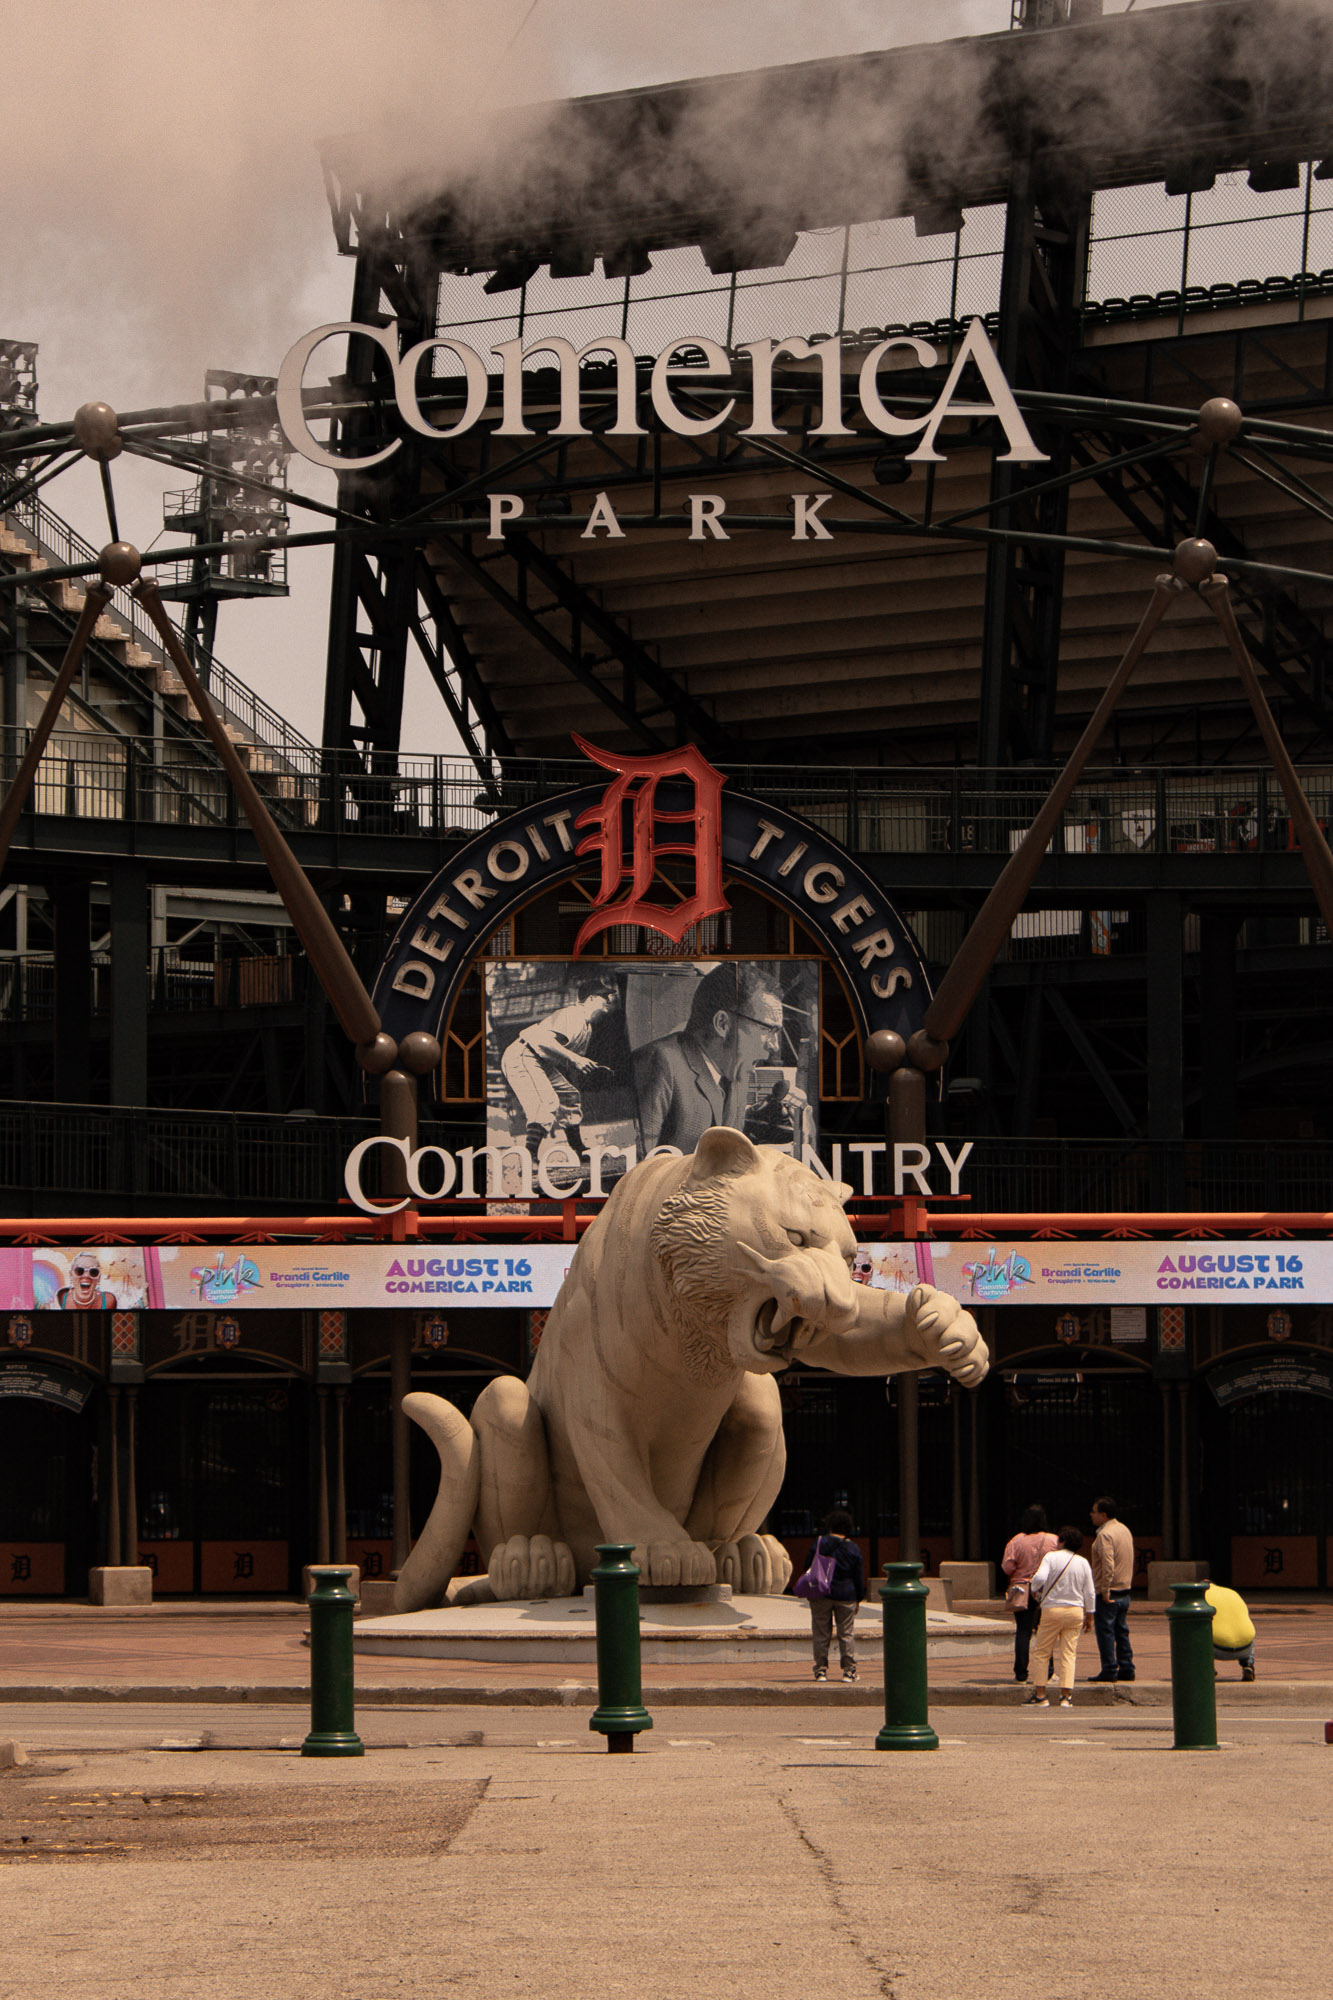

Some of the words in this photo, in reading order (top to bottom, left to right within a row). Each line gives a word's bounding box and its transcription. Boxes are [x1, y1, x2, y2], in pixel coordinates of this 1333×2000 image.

[485, 493, 836, 541] PARK
[391, 809, 579, 1000] DETROIT
[755, 818, 913, 999] TIGERS
[344, 1135, 698, 1215] Comer
[756, 1142, 974, 1196] NTRY
[385, 1259, 499, 1277] AUGUST
[504, 1259, 532, 1277] 16
[1041, 1268, 1081, 1277] Brandi
[1083, 1268, 1121, 1277] Carlile
[1157, 1255, 1270, 1273] AUGUST
[1275, 1255, 1303, 1273] 16
[270, 1272, 310, 1281] Brandi
[312, 1272, 350, 1281] Carlile
[1156, 1277, 1250, 1289] COMERICA
[1253, 1277, 1304, 1289] PARK
[385, 1280, 479, 1293] COMERICA
[482, 1281, 533, 1293] PARK
